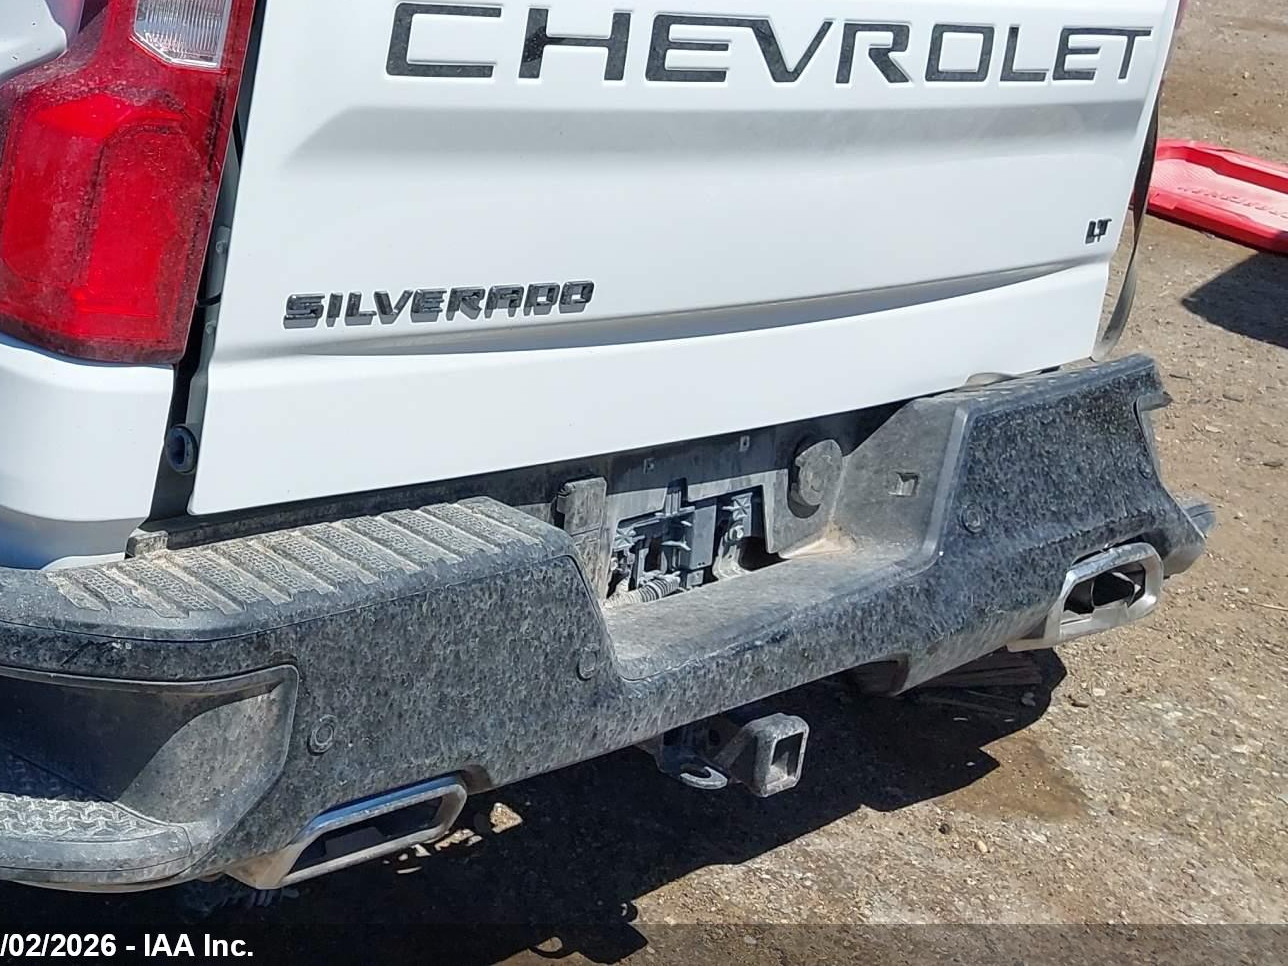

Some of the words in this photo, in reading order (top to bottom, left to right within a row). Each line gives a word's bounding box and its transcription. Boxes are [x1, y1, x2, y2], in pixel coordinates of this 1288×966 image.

[384, 1, 1153, 85] CHEVROLET
[1085, 218, 1112, 244] LT
[283, 280, 595, 329] SILVERADO
